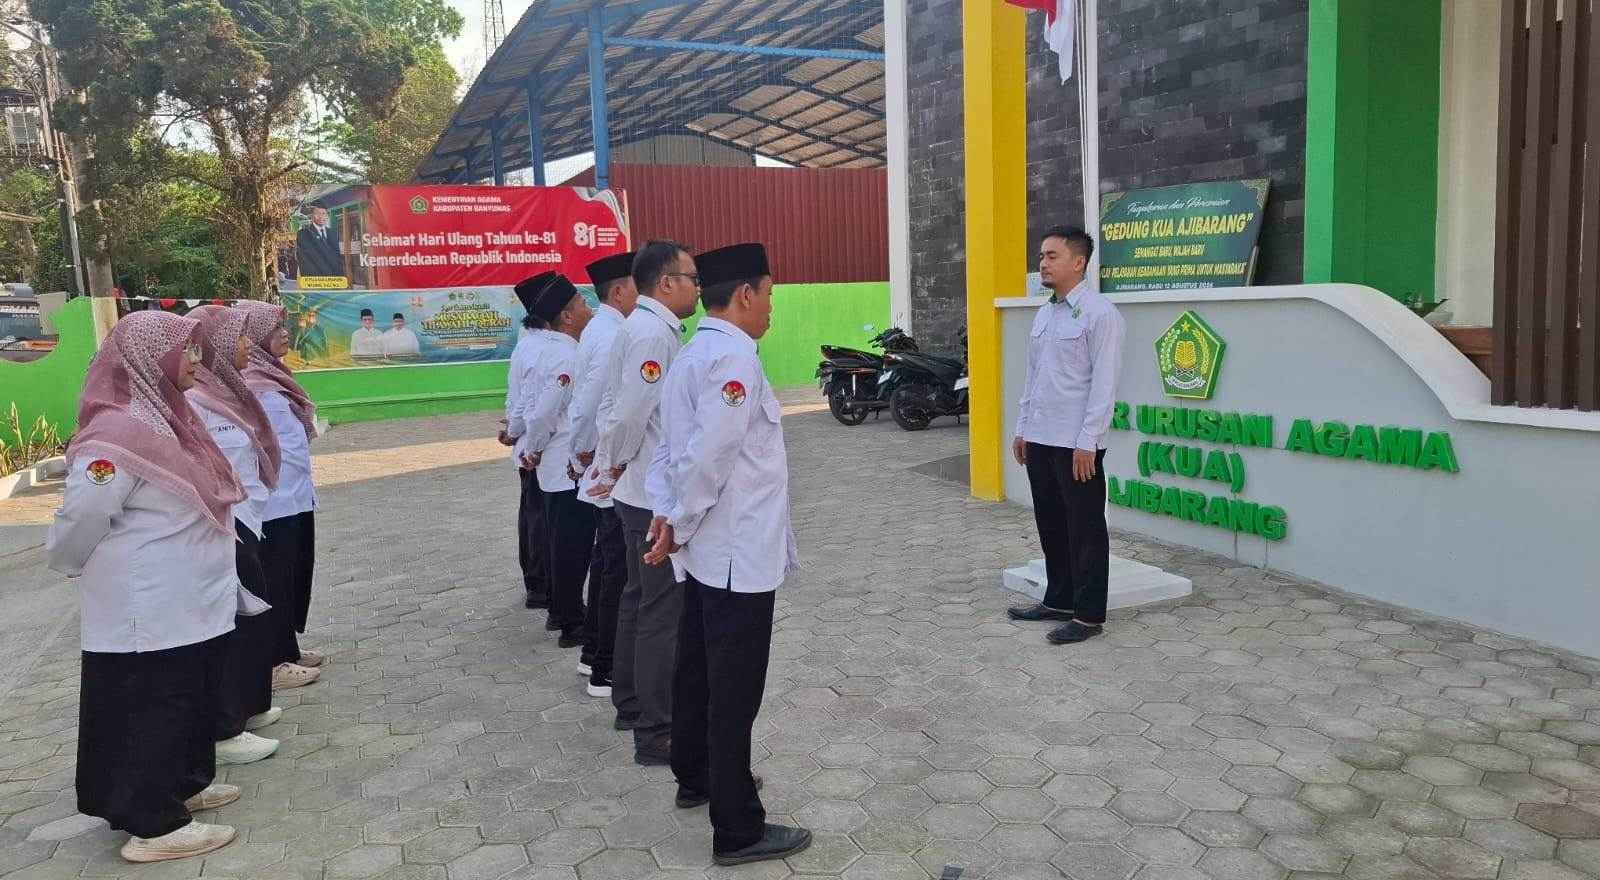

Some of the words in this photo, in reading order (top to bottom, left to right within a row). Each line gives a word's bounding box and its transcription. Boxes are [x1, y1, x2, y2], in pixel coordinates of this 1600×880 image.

[433, 204, 473, 212] KABUPATEN
[474, 204, 512, 212] BANYUMAS
[1151, 218, 1174, 237] KUA
[362, 233, 415, 247] Selamat
[418, 232, 445, 246] Hari
[447, 231, 482, 248] Ulang
[484, 231, 522, 245] Tahun
[524, 231, 556, 244] ke-81
[359, 252, 447, 267] Kemerdekaan
[450, 249, 503, 267] Republik
[505, 250, 562, 263] Indonesia
[1136, 404, 1273, 449] URUSAN
[1285, 417, 1460, 474] AGAMA
[1137, 441, 1245, 494] (KUA)
